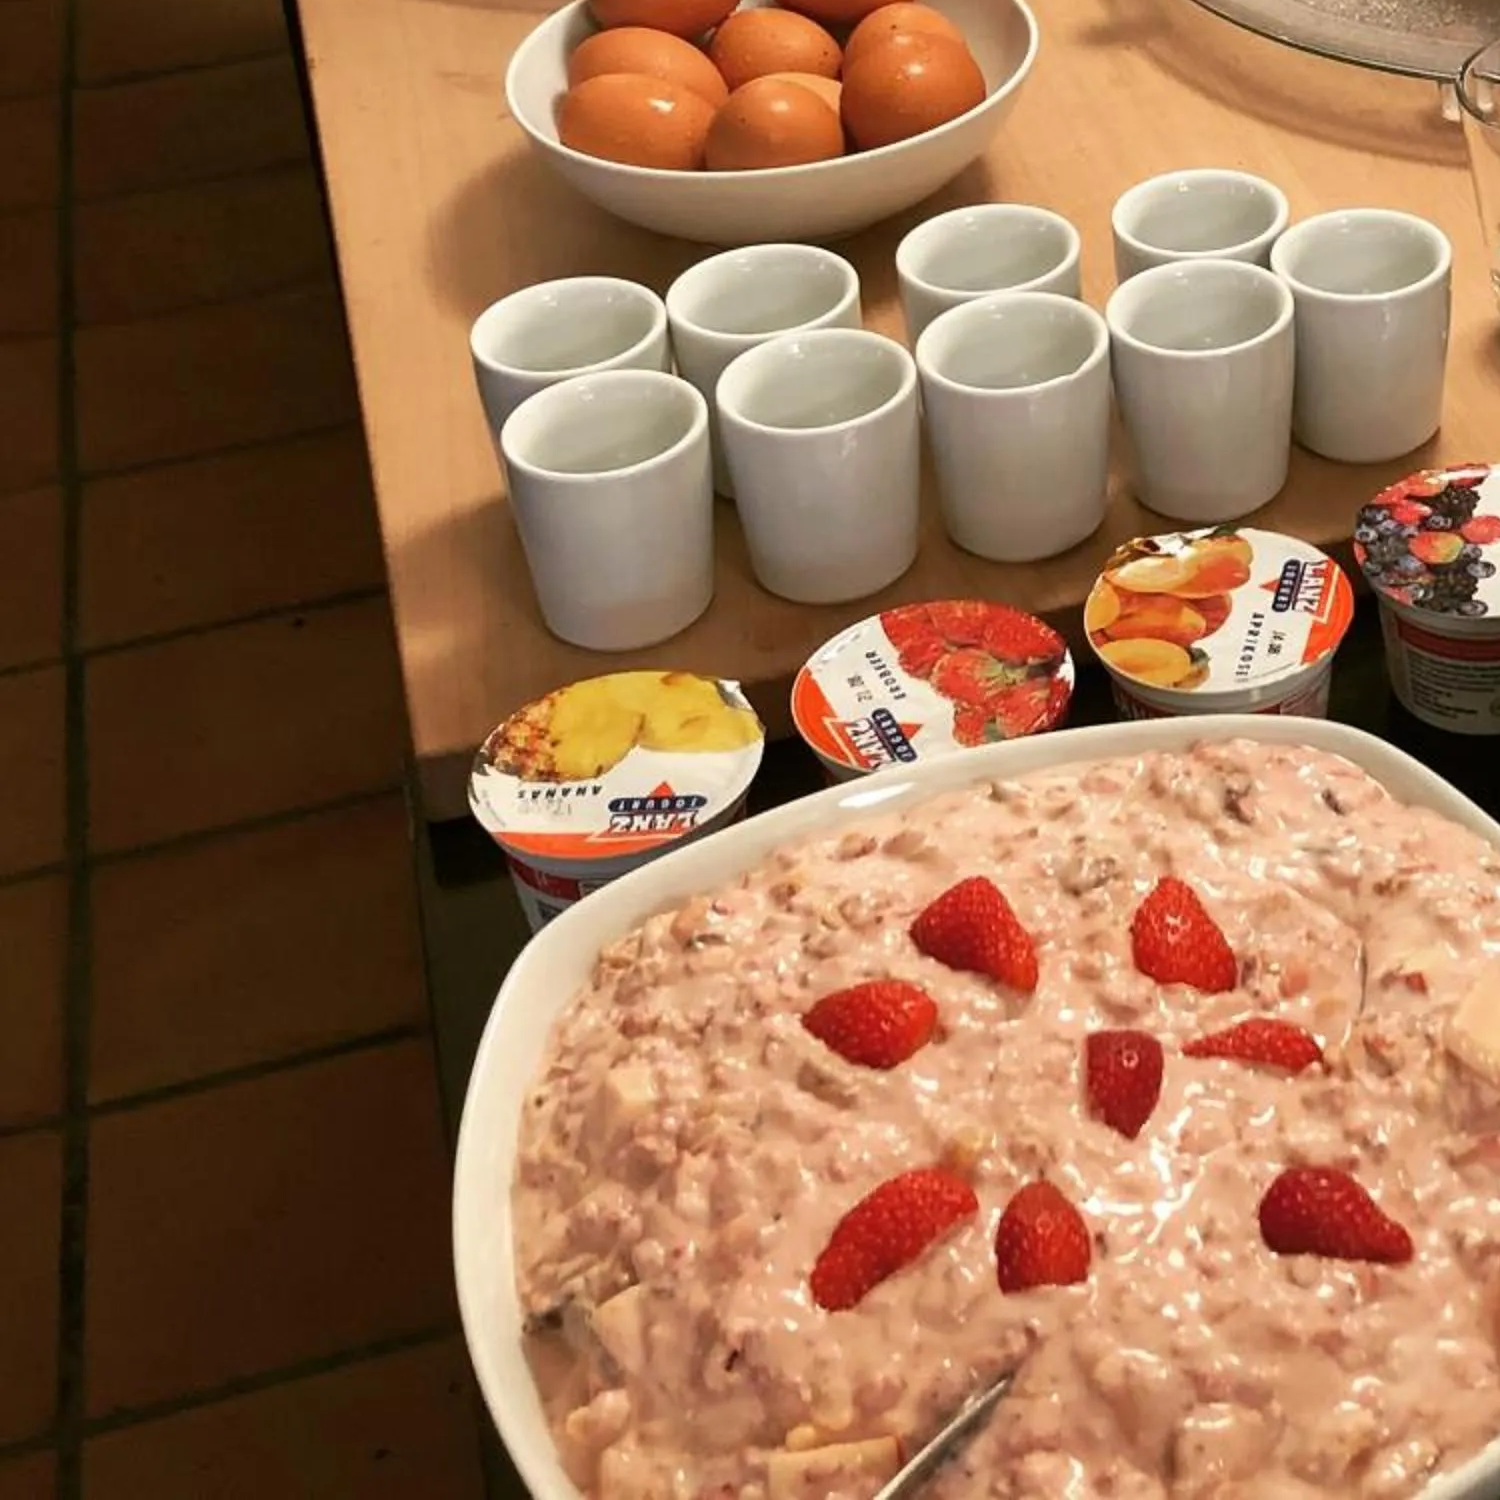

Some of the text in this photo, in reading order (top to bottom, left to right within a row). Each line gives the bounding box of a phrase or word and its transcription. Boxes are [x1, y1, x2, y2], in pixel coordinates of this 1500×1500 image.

[1294, 560, 1328, 613] LANZ
[865, 650, 907, 701] ERDBEER
[518, 786, 602, 799] ANANAS
[618, 796, 699, 812] JOGURT
[608, 811, 698, 834] LANZ
